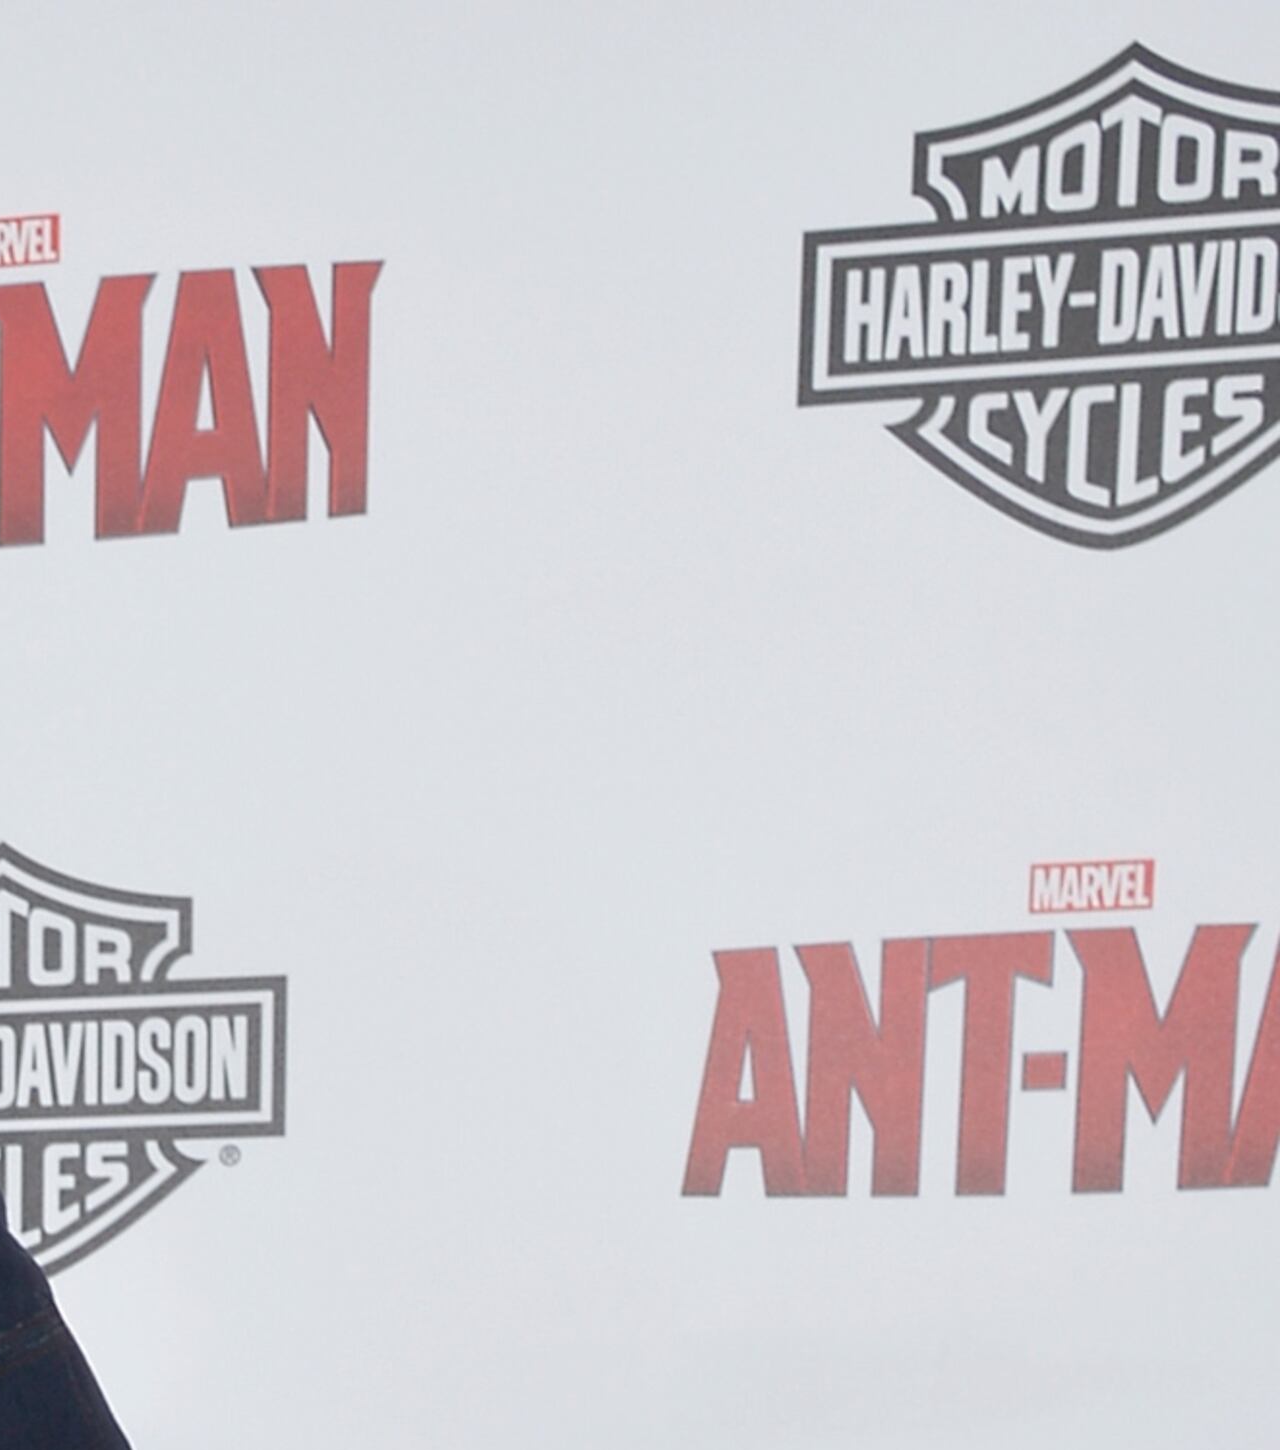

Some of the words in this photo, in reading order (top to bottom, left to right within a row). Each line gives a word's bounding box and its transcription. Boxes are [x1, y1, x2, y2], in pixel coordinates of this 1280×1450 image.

[979, 94, 1280, 219] MOTOR
[843, 236, 1280, 364] HARLEY-DAVID
[966, 374, 1265, 508] CYCLES
[1030, 858, 1155, 914] MARVEL
